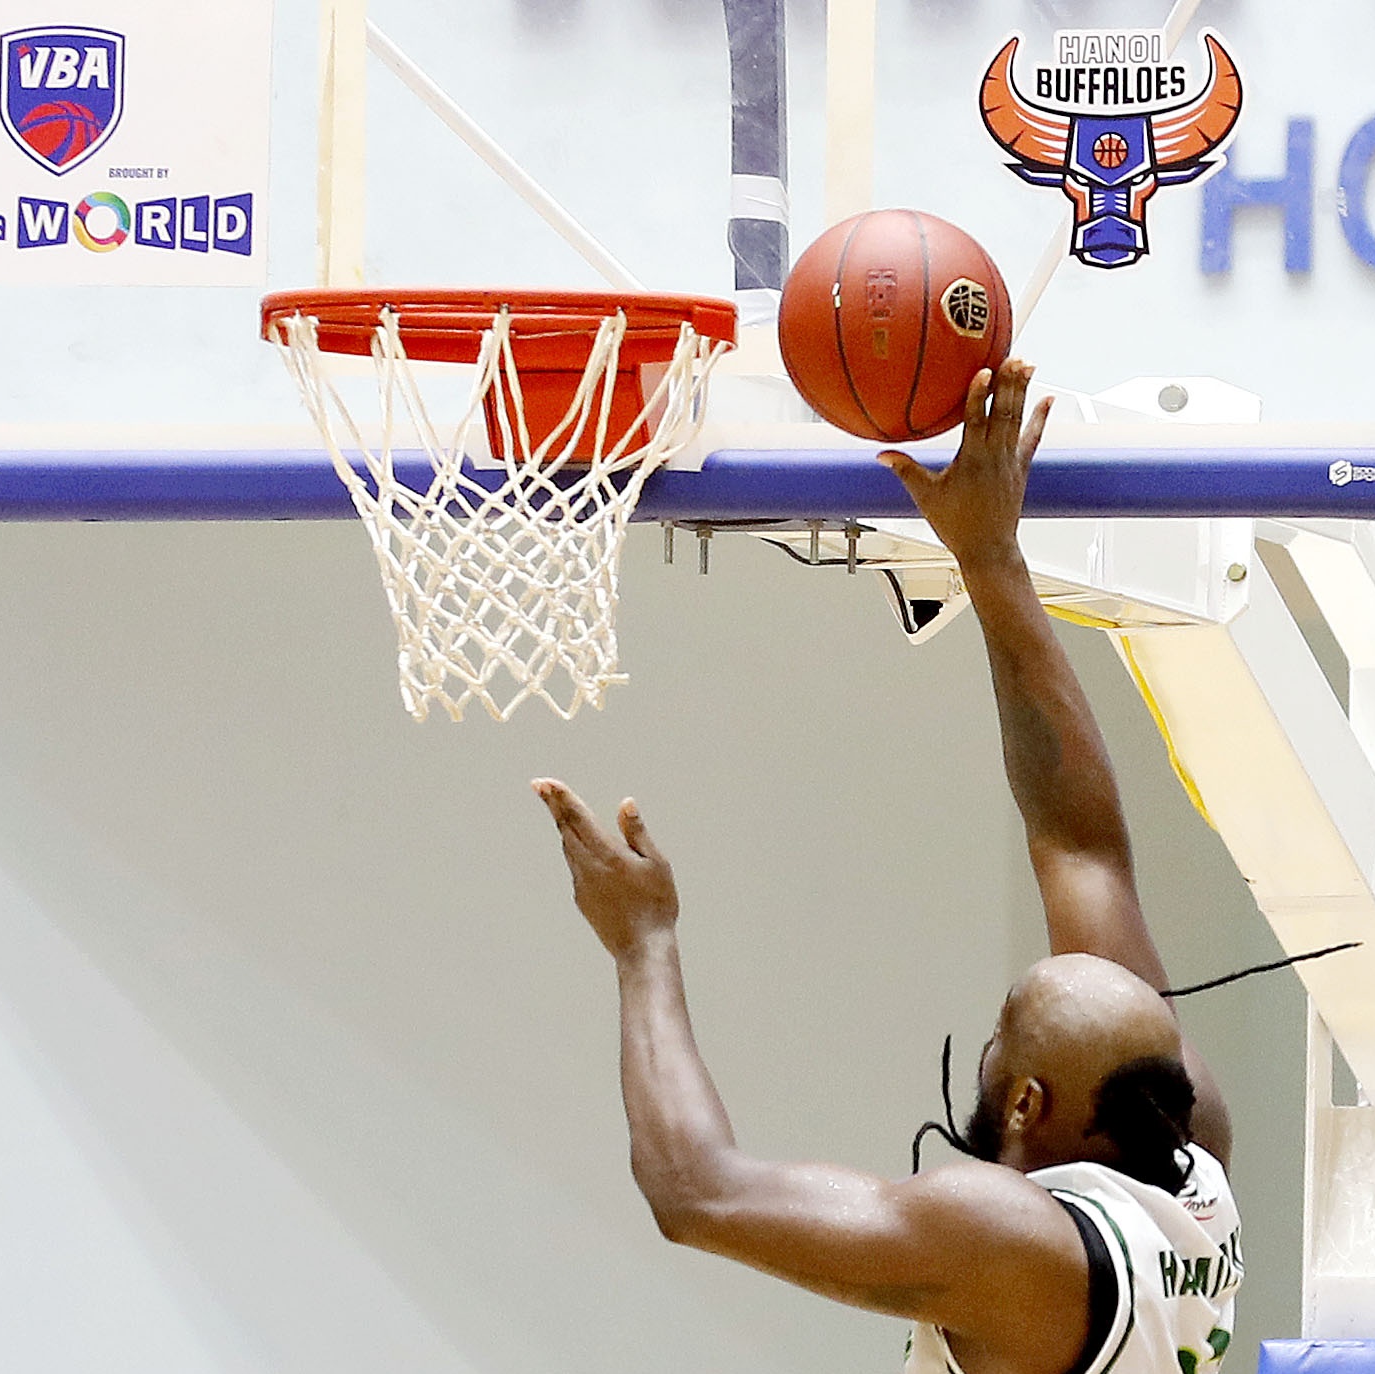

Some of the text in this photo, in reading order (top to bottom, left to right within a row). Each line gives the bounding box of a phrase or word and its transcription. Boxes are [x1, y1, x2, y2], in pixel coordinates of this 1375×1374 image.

[19, 46, 111, 90] VBA
[1059, 35, 1162, 64] HANOI
[1036, 66, 1186, 105] BUFFALOES
[970, 289, 989, 333] VBA
